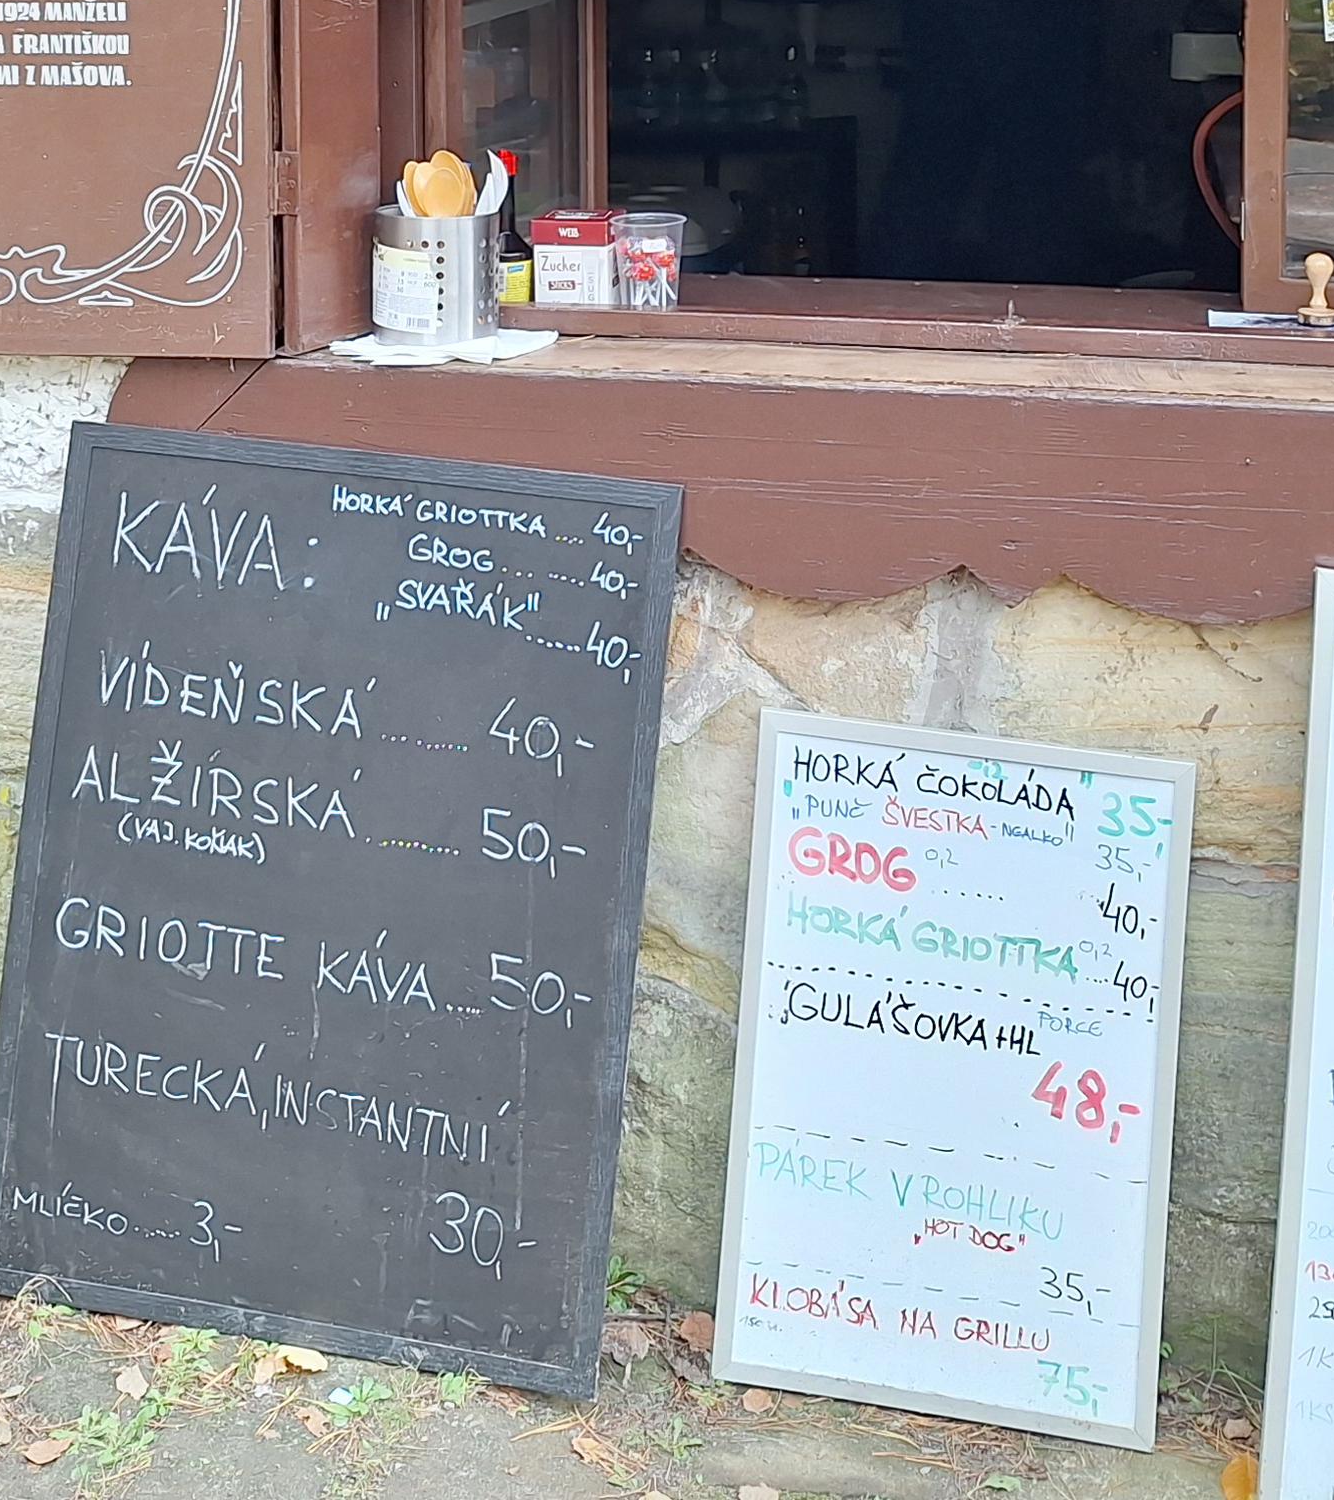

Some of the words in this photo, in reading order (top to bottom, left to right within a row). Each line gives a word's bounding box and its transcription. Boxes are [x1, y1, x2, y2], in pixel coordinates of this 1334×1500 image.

[12, 30, 130, 55] FRANTIŠKOU
[25, 65, 36, 86] Z
[40, 61, 132, 86] MAŠOVA.
[541, 255, 581, 272] Zucker
[332, 483, 413, 516] HORKÁ
[416, 500, 547, 539] GRIOTTKA
[592, 512, 644, 555] 40,-
[407, 534, 495, 573] GROG
[589, 561, 639, 600] 40,-
[585, 621, 643, 684] 40,-
[100, 641, 376, 740] VÍDEŇSKÁ
[488, 697, 595, 777] 40,-
[72, 738, 362, 839] ALŽÍRSKÁ
[481, 807, 587, 879] 50,-
[792, 744, 906, 792] HORKÁ
[916, 764, 1076, 821] ČOKOLÁDA
[881, 795, 989, 840] ŠVESTKA
[788, 826, 917, 892] GROG
[53, 896, 285, 980] GRIOTTE
[316, 929, 438, 1013] KÁVA
[487, 951, 593, 1030] 50,-
[787, 892, 909, 951] HORKÁ
[911, 921, 1079, 983] GRIOTTKA
[788, 982, 987, 1050] GULÁŠOVKA
[1038, 1010, 1103, 1037] PORCE
[1031, 1061, 1141, 1143] 48,-
[753, 1138, 872, 1201] PÁREK
[890, 1169, 913, 1207] V
[922, 1175, 1064, 1240] ROHLIKU
[189, 1200, 243, 1263] 3,-
[428, 1192, 538, 1280] 30,-
[900, 1307, 937, 1340] NA
[953, 1318, 1051, 1352] GRILLU
